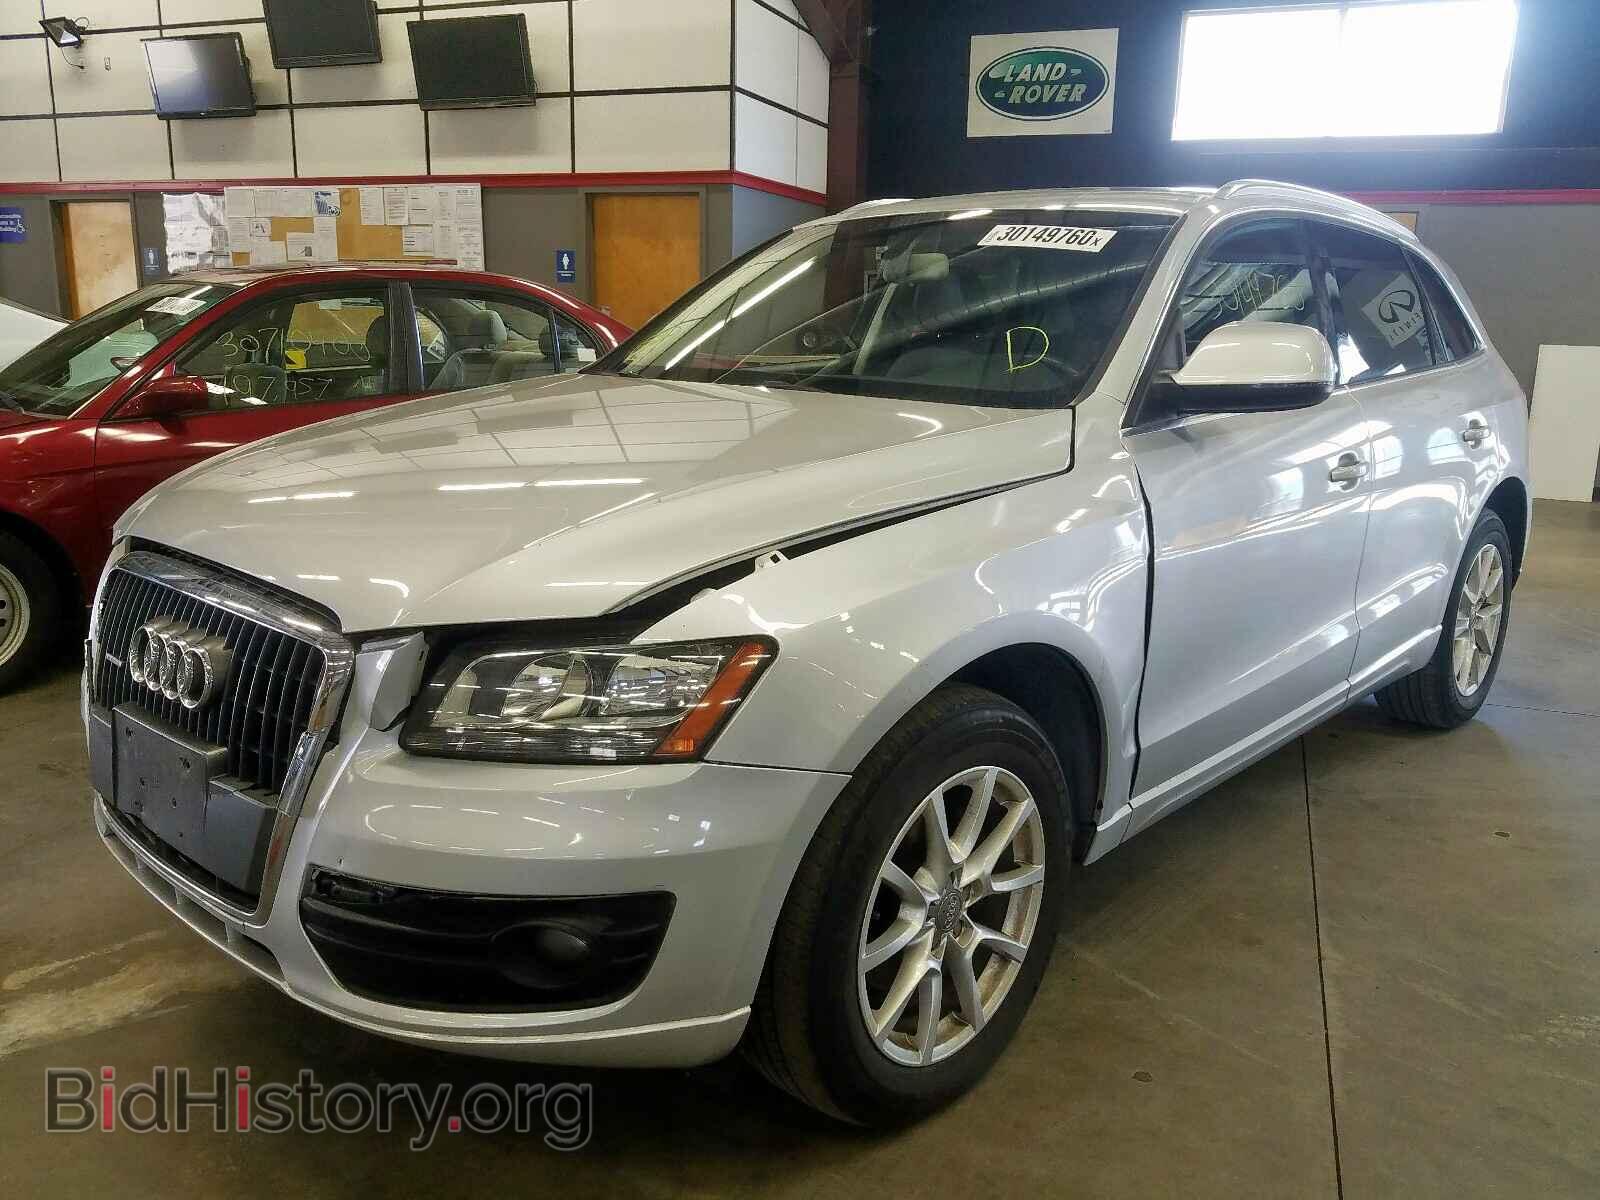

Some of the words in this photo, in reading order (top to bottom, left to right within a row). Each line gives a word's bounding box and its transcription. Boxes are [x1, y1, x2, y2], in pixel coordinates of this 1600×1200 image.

[1004, 63, 1066, 82] LAND
[1008, 84, 1087, 104] ROVER
[1006, 326, 1050, 374] D
